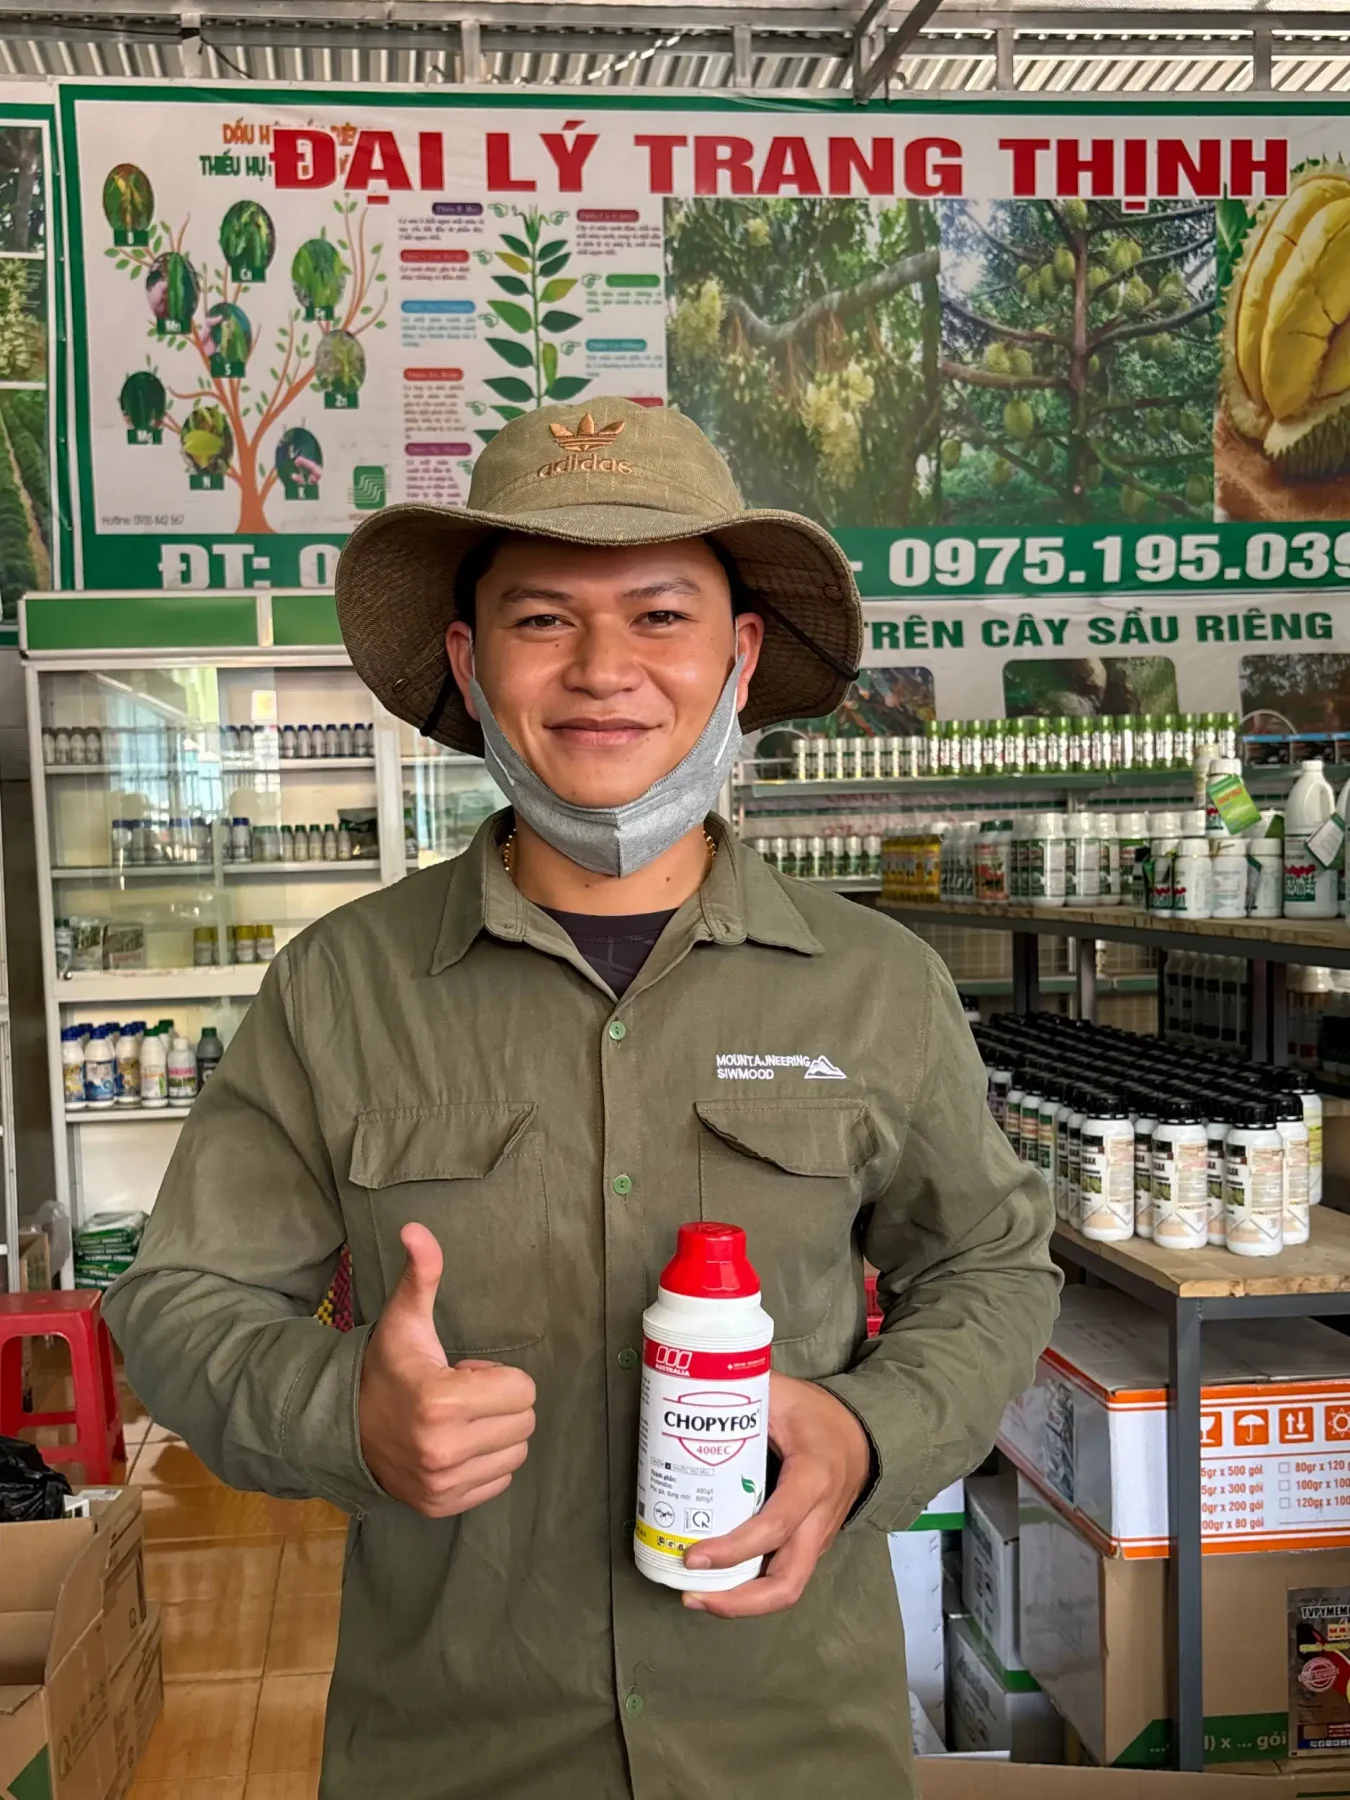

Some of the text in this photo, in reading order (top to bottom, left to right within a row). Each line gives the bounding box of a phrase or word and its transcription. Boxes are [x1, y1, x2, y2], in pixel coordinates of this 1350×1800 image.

[269, 128, 445, 206] ĐẠI
[485, 120, 599, 193] LÝ
[634, 134, 963, 198] TRANG
[998, 138, 1288, 211] THỊNH
[537, 453, 633, 478] adidas
[158, 543, 271, 589] ĐT:
[864, 605, 1334, 650] RÊN CÂY SẦU RIÊNG
[716, 1067, 775, 1080] SIWMOOD
[655, 1362, 691, 1377] AUSTRALIA
[664, 1410, 757, 1432] CHOPYFOS
[696, 1444, 732, 1456] 400EC
[1200, 1464, 1264, 1479] 5gr x 500 gói
[1295, 1462, 1317, 1474] 80gr
[1319, 1462, 1325, 1471] x
[1328, 1460, 1345, 1470] 120
[1201, 1481, 1264, 1496] 5gr x 300 gói
[1296, 1480, 1323, 1491] 100gr
[1325, 1480, 1331, 1489] x
[1202, 1499, 1264, 1514] 0gr x 200 gói
[1296, 1497, 1324, 1508] 120gr
[1326, 1497, 1331, 1507] x
[1202, 1516, 1264, 1531] 00gr x 80 gói
[1302, 1605, 1350, 1618] TVPYMEM
[1220, 1737, 1231, 1748] x
[1256, 1731, 1287, 1751] gói
